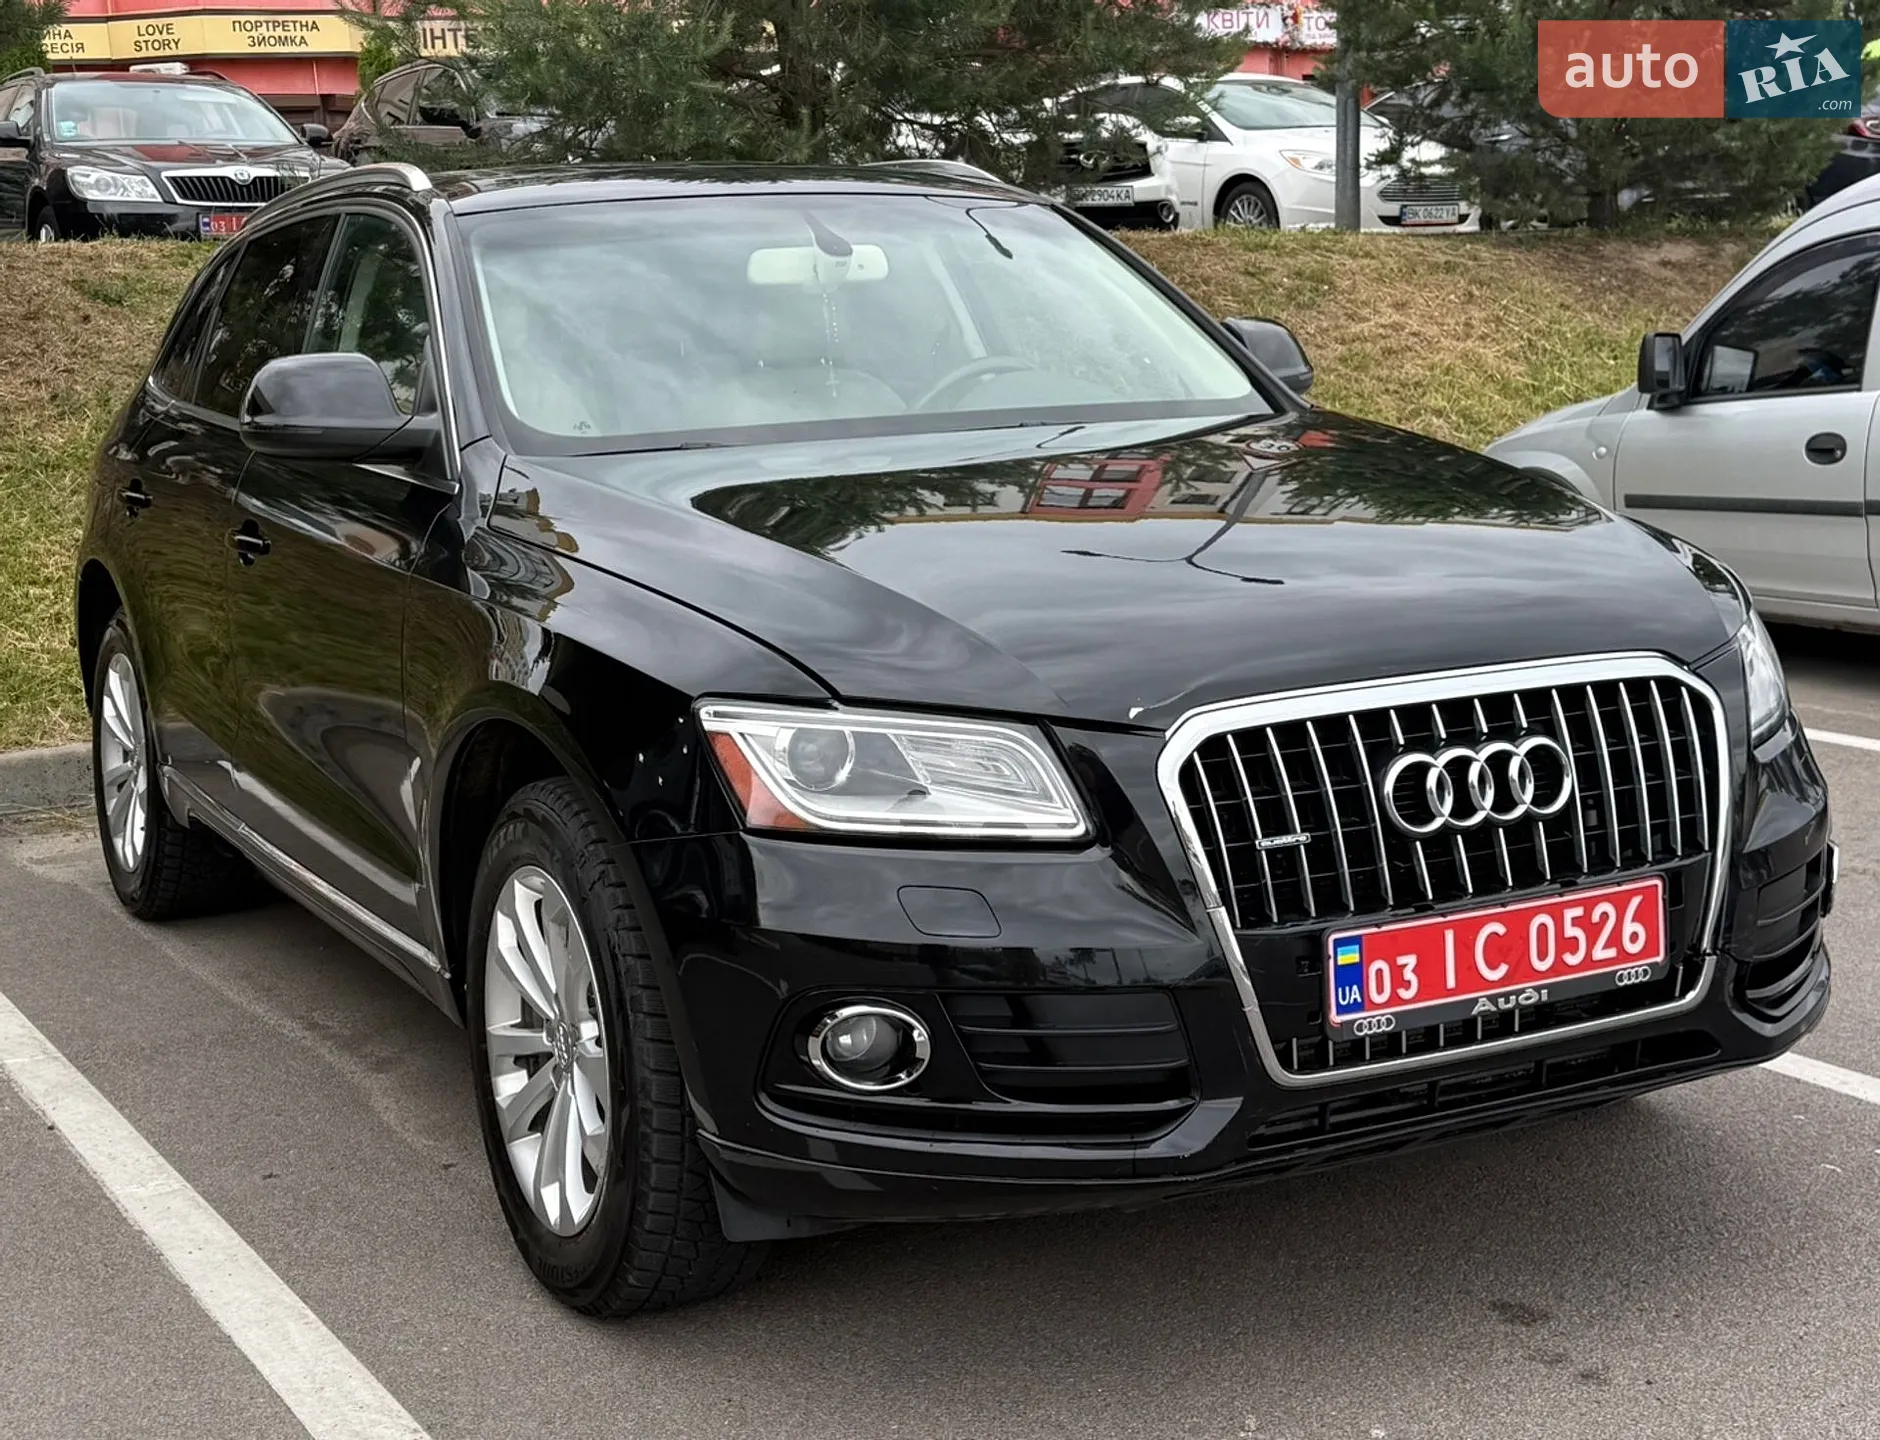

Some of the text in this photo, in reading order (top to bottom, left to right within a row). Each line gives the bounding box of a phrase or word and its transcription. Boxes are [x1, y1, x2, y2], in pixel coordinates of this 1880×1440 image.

[231, 20, 320, 32] ПОРТРЕТНА
[1206, 12, 1270, 30] КВІТИ
[137, 23, 175, 37] LOVE
[133, 38, 181, 52] STORY
[247, 33, 309, 47] ЗЙОМКА
[1367, 953, 1419, 1005] 03
[1528, 894, 1647, 972] 0526
[1337, 984, 1362, 1005] UA
[1470, 987, 1549, 1016] Audi
